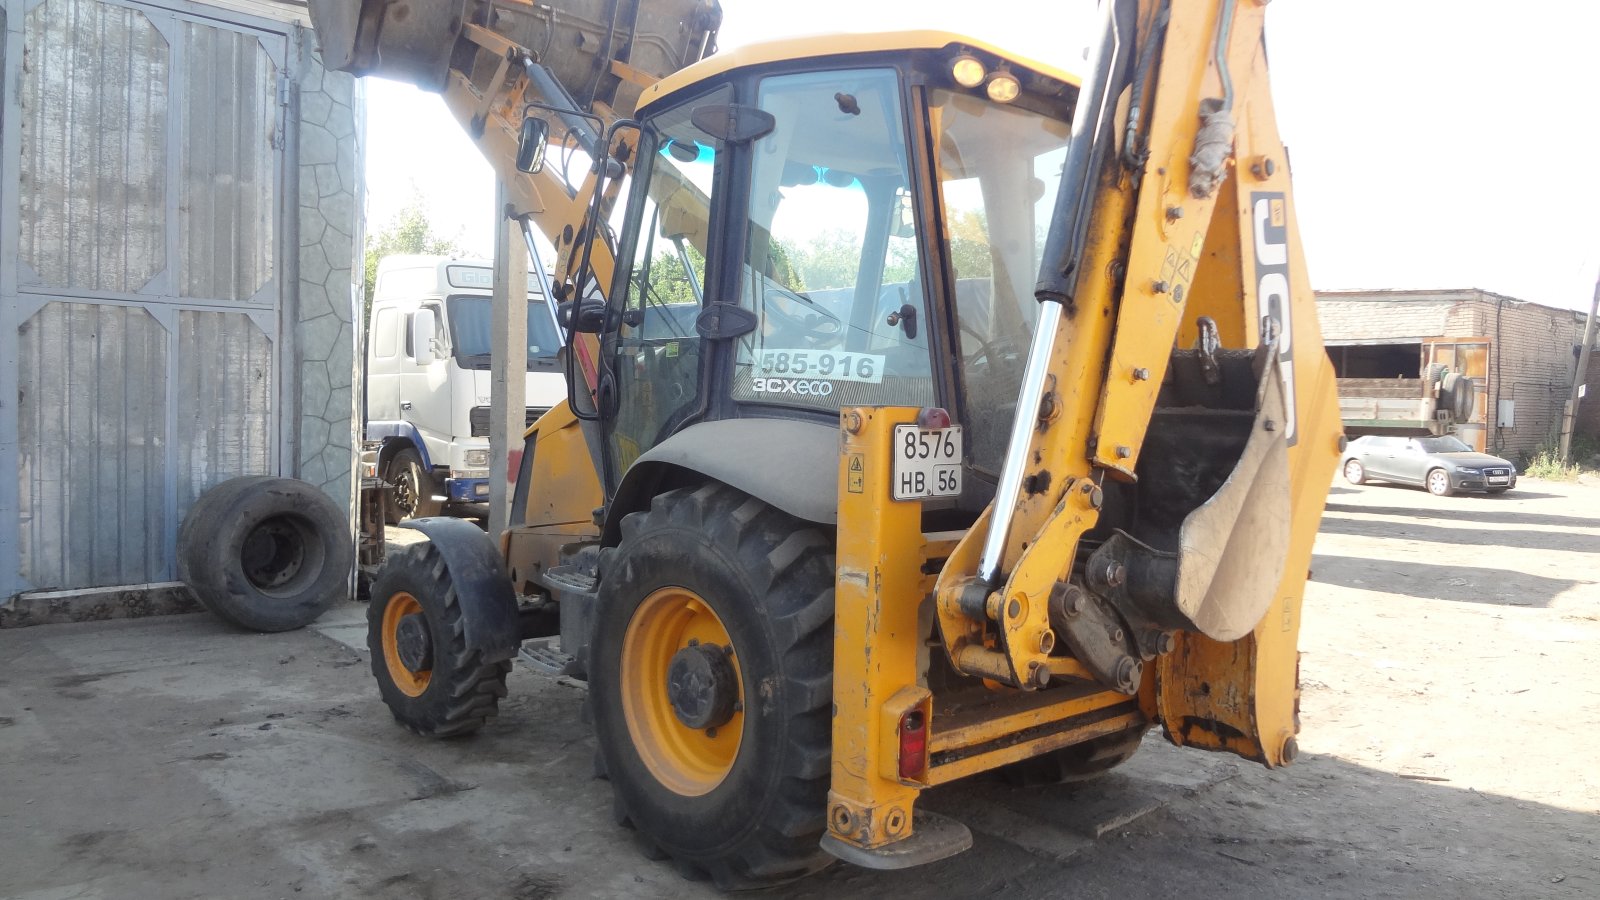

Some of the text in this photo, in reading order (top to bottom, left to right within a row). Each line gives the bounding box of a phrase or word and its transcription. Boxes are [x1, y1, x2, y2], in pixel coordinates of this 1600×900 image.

[762, 352, 875, 379] 585-916
[904, 431, 955, 460] 8576
[938, 470, 957, 492] 56
